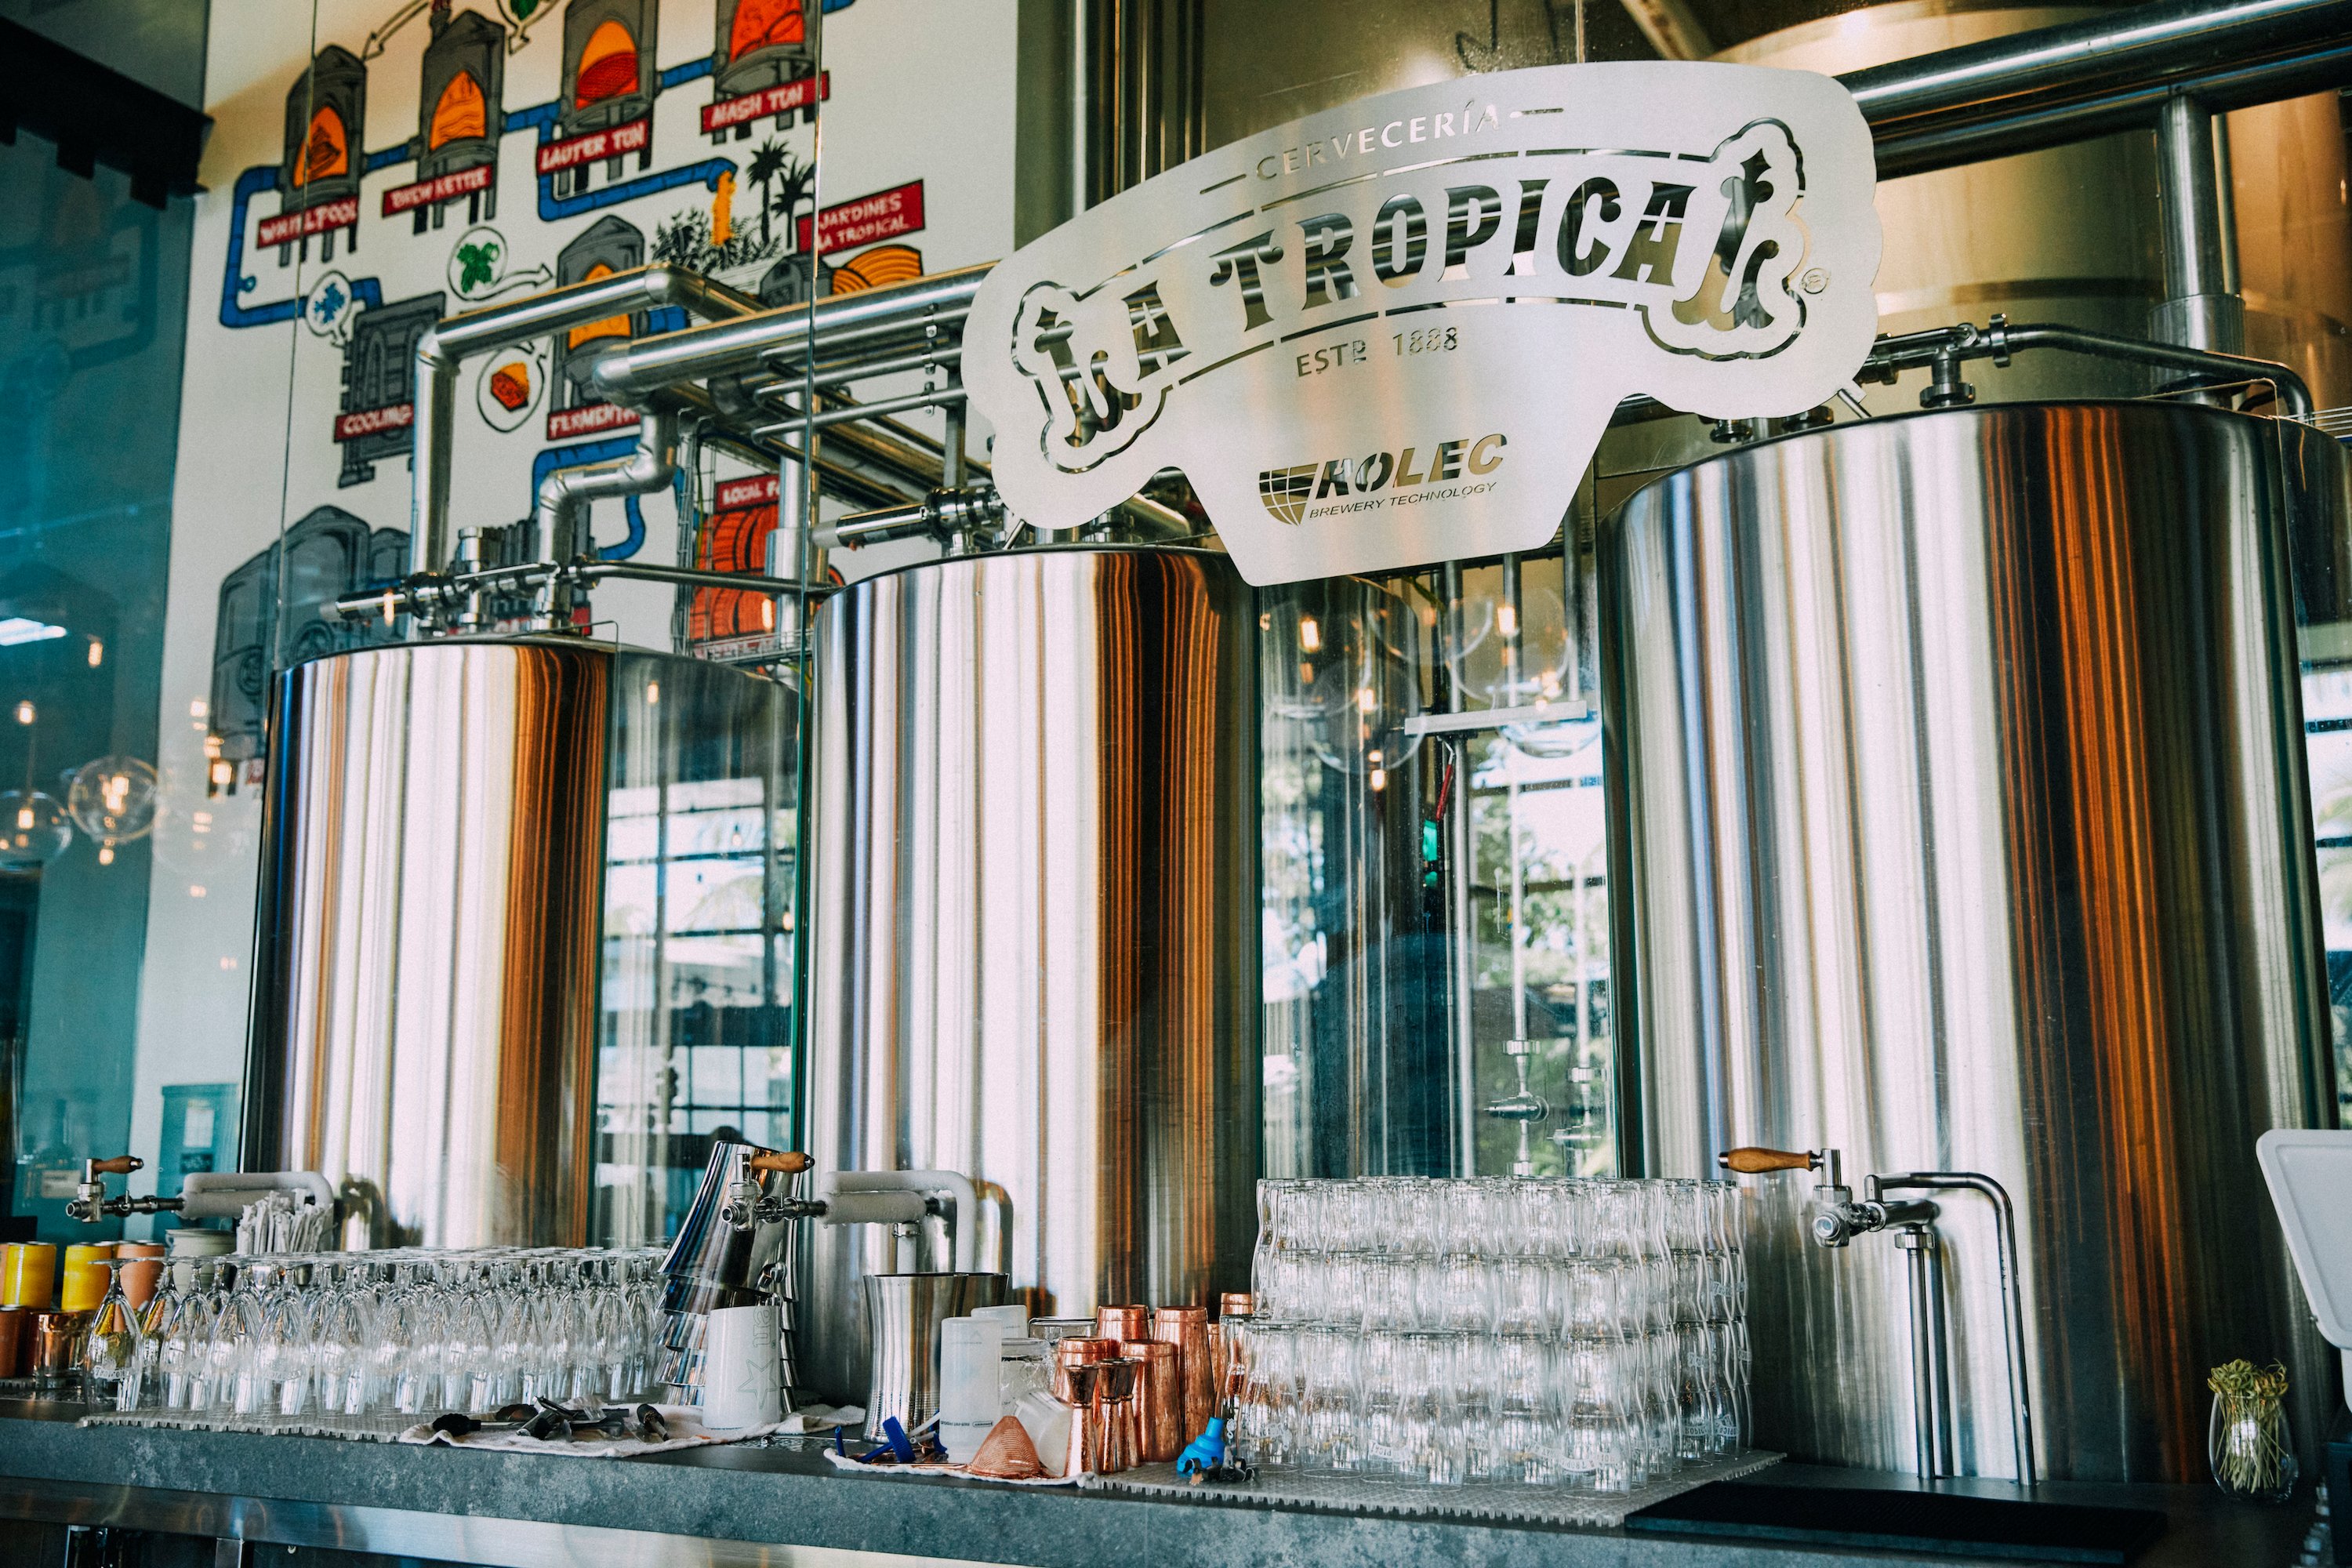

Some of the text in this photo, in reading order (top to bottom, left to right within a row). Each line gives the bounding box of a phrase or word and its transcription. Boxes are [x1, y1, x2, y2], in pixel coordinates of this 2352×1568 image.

[710, 89, 763, 126] MASH
[540, 135, 607, 171] LAUTER
[1257, 98, 1501, 181] CERVECERÍA
[819, 194, 902, 230] JARDINES
[837, 215, 910, 245] TROPICAL
[1033, 146, 1782, 443] LA TROPICAL
[1392, 327, 1457, 355] 1888
[1309, 481, 1497, 518] BREWERY TECHNOLOGY
